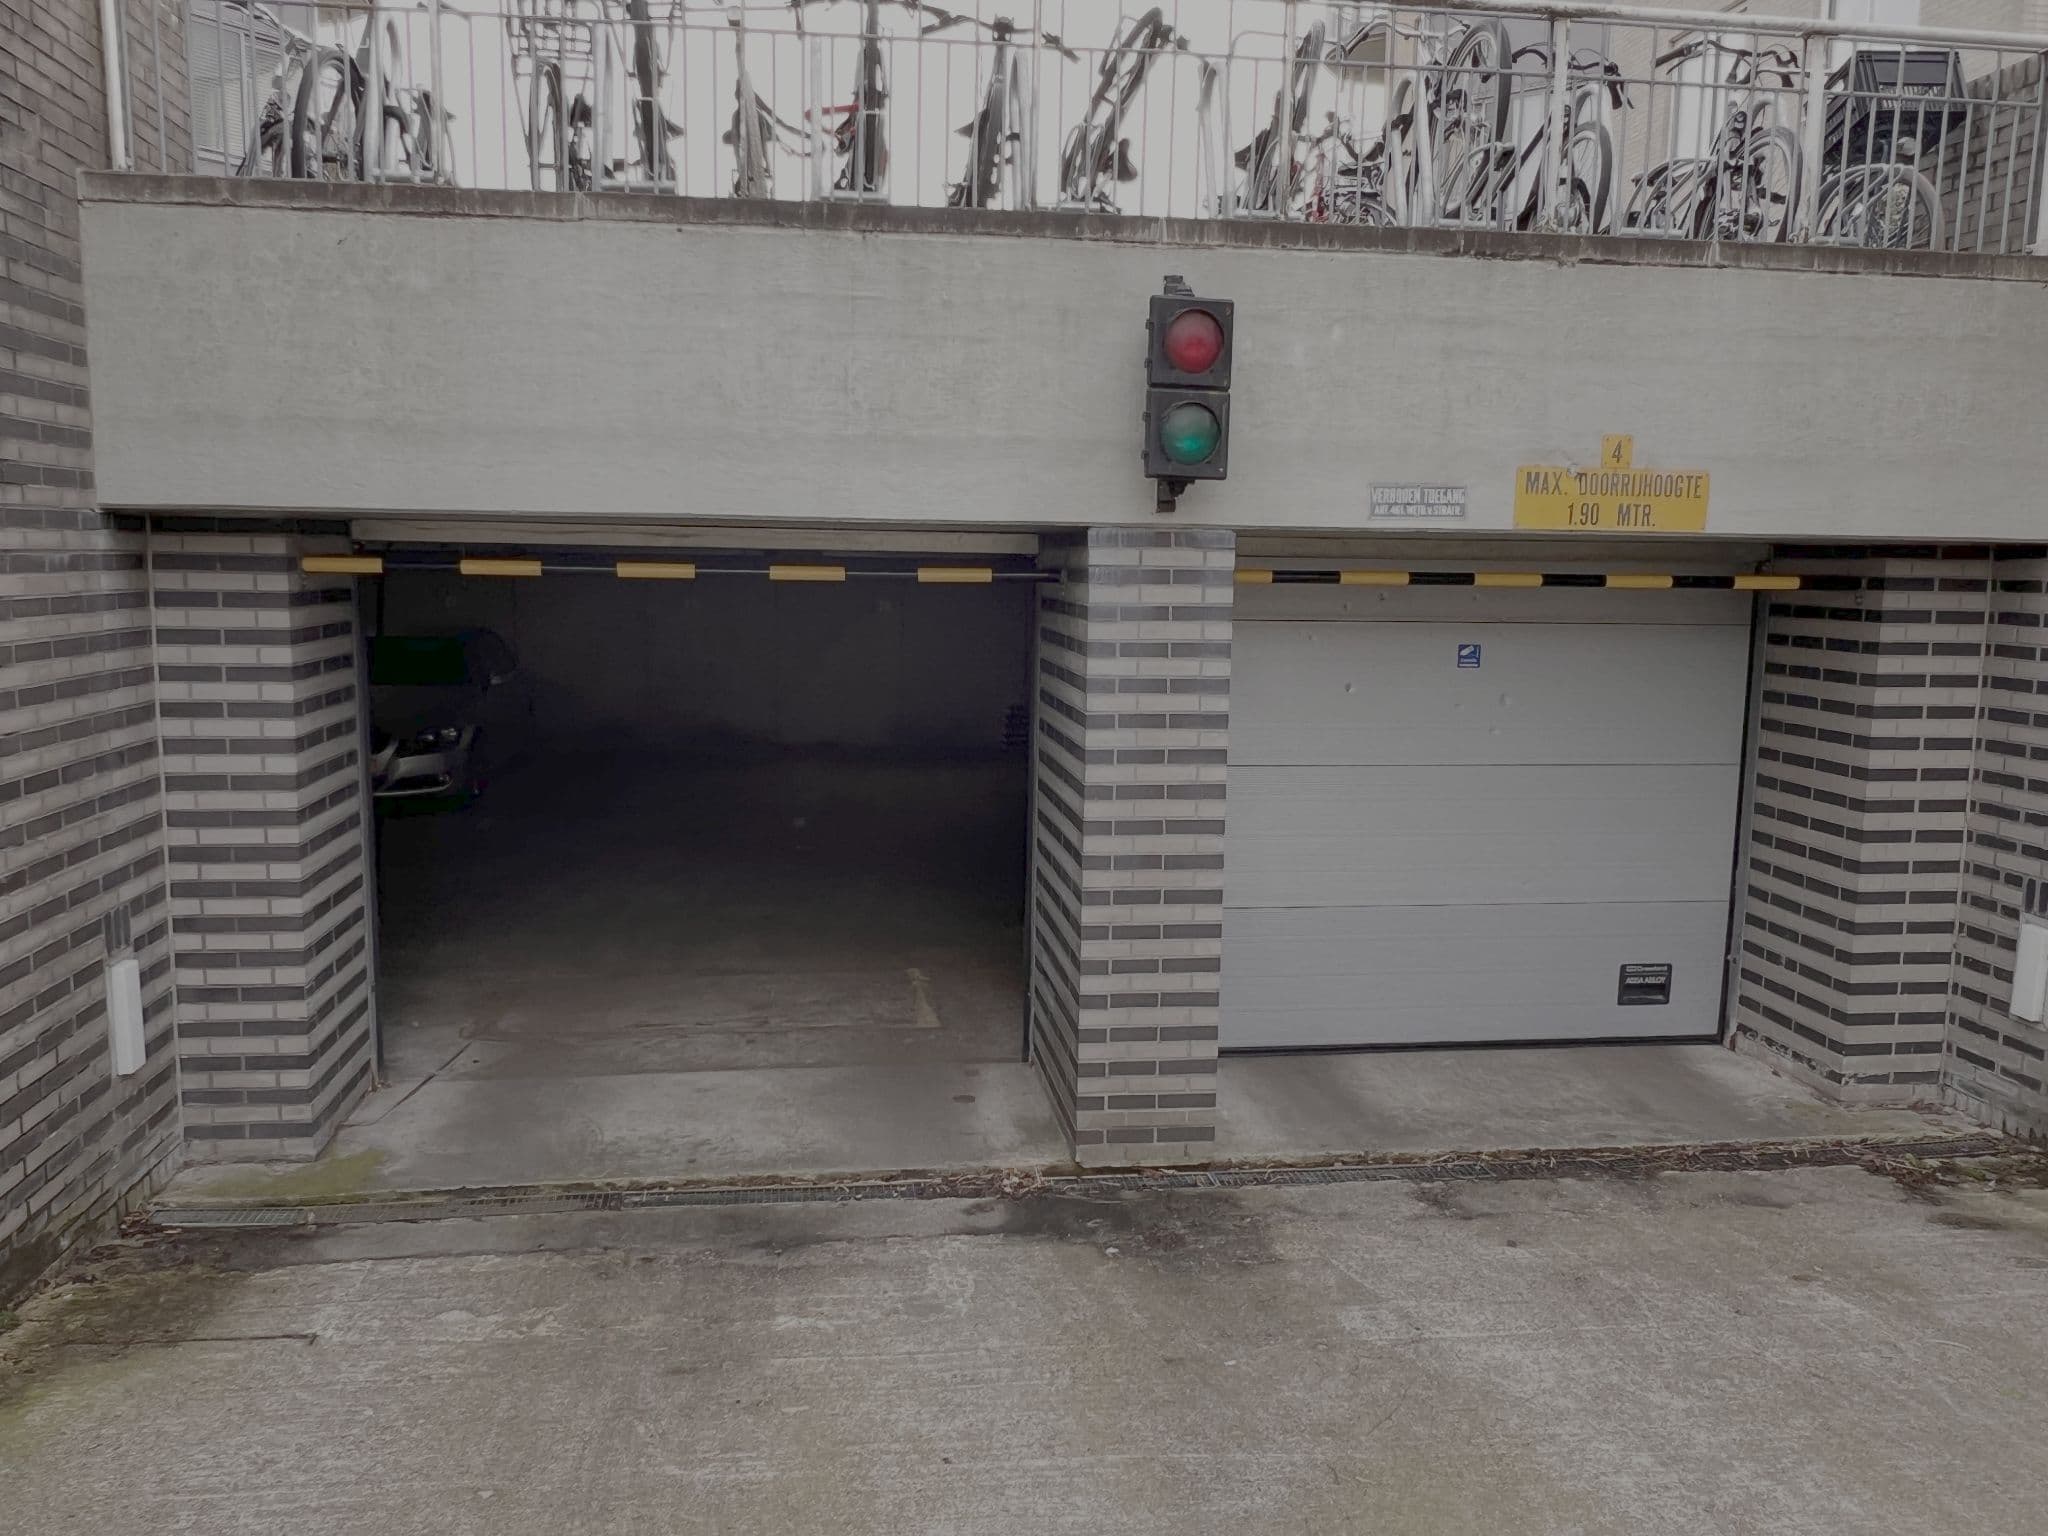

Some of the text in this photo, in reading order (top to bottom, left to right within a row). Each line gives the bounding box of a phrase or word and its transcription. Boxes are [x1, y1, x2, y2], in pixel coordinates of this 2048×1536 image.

[1611, 439, 1624, 464] 4
[1371, 487, 1465, 504] VERBODEN TOEGANG
[1525, 471, 1704, 499] MAX. DOORRIJHOOGTE
[1567, 502, 1656, 527] 1.90 MTR.
